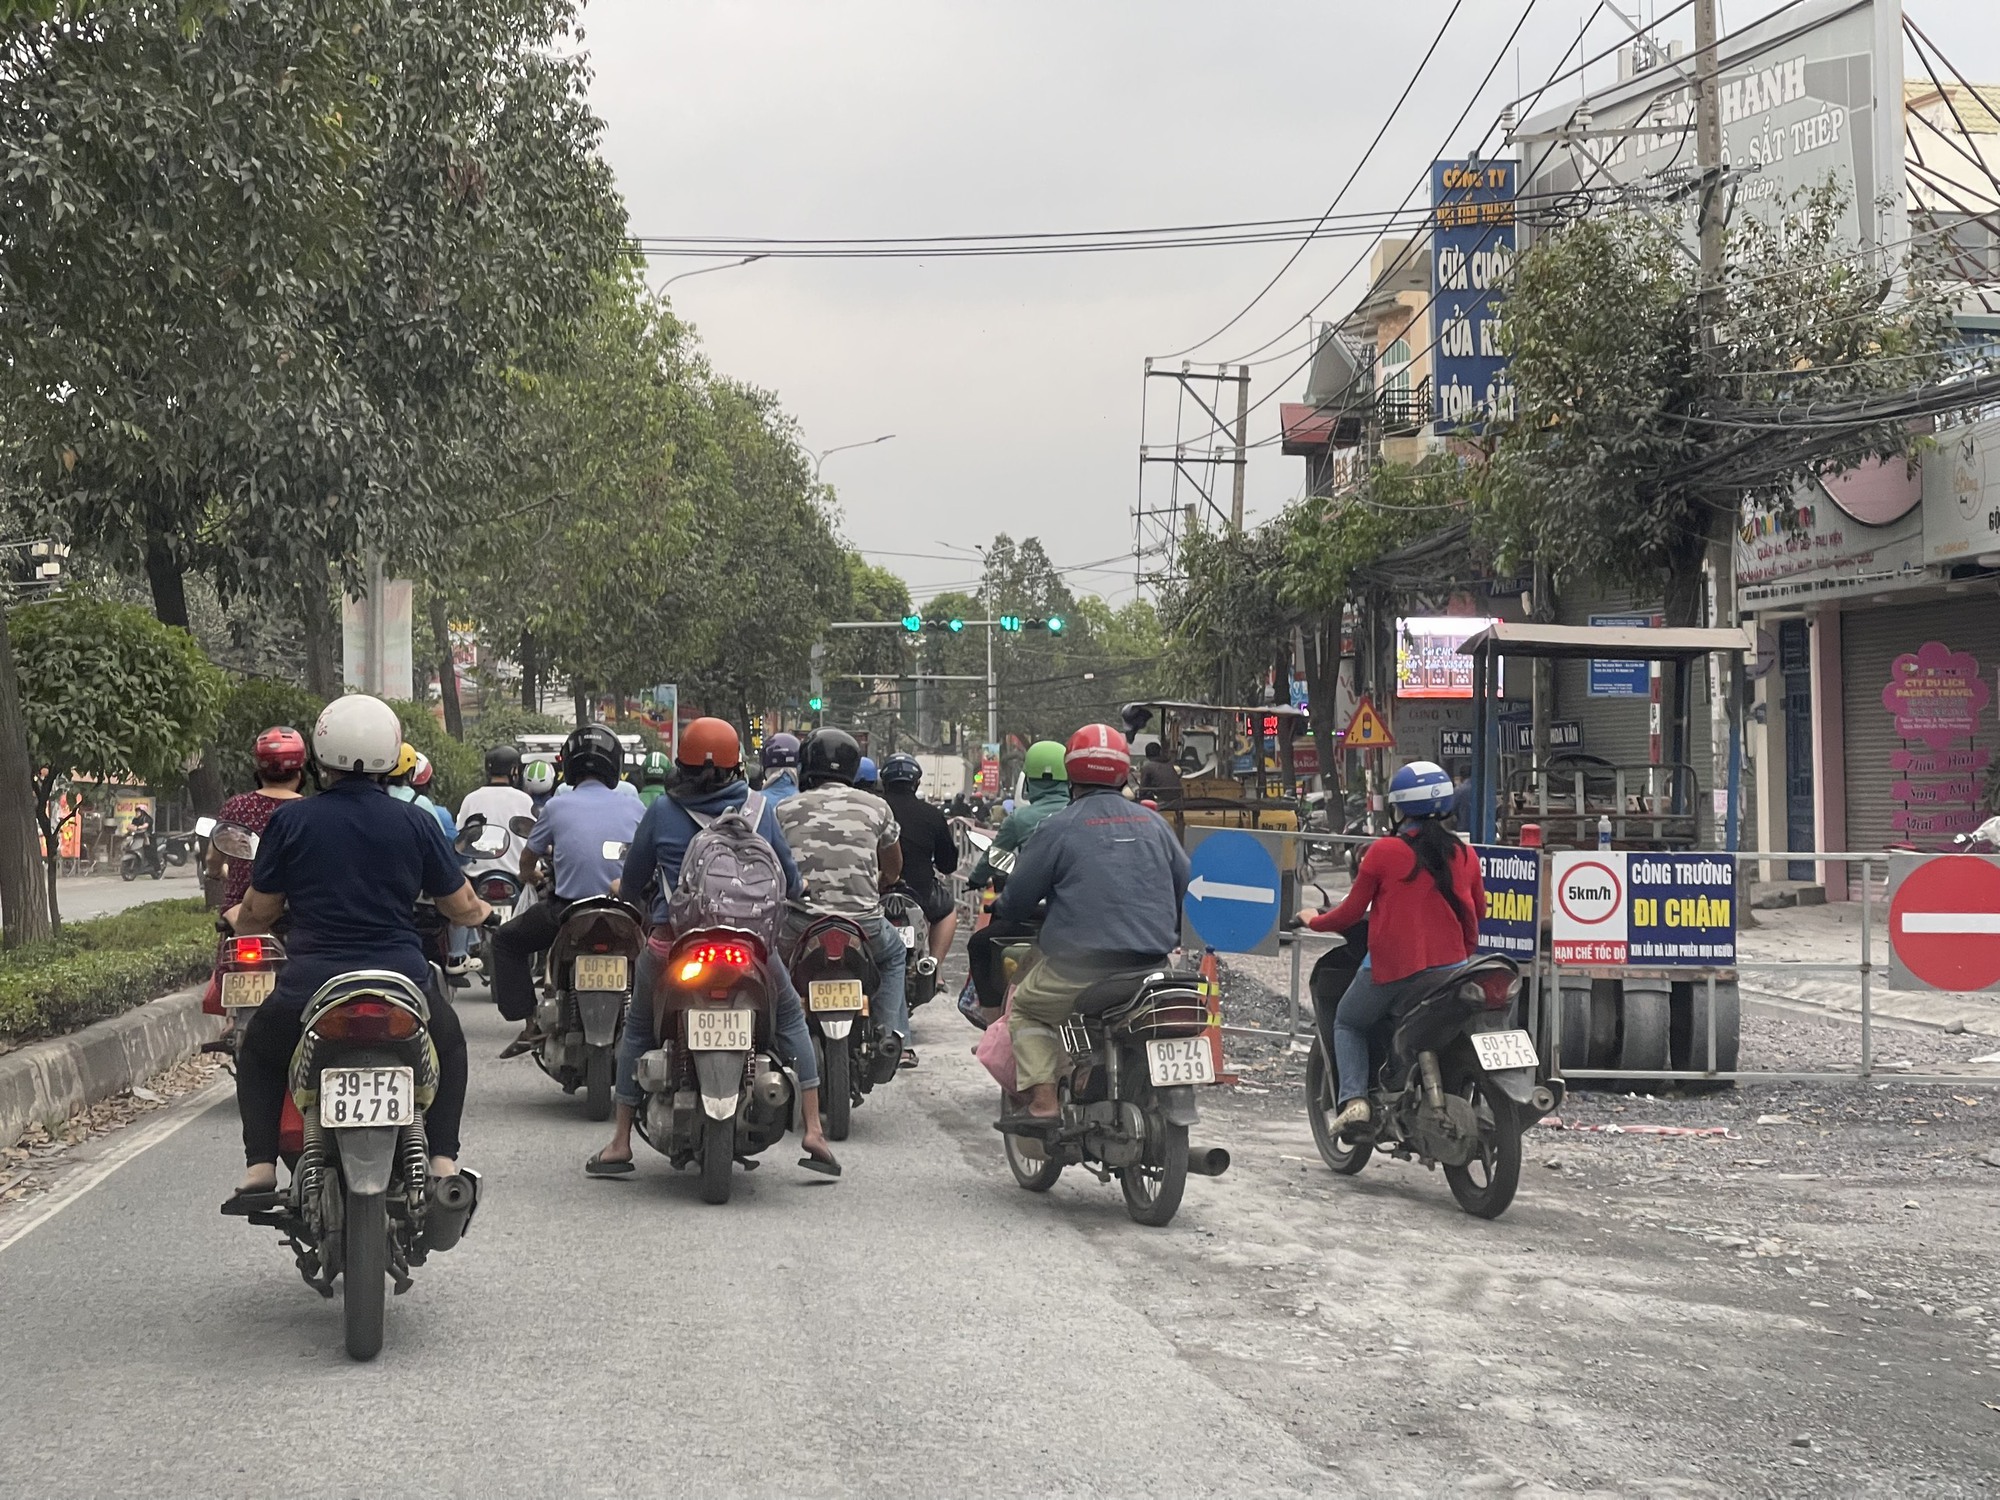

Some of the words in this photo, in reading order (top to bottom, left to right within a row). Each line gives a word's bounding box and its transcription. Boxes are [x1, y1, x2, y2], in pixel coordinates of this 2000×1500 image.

[1718, 55, 1805, 126] HÀNH
[1749, 115, 1786, 168] SẮT
[1790, 102, 1845, 156] THÉP
[1442, 163, 1484, 188] CÔNG
[1487, 168, 1507, 188] TY
[1441, 304, 1475, 357] CỬA
[1480, 309, 1514, 357] KÉ
[1440, 373, 1473, 422] TÔN
[1988, 505, 2000, 535] GỘ
[1896, 689, 1935, 698] PACIFIC
[1937, 689, 1975, 698] TRAVEL
[1904, 679, 1923, 687] CTY
[1926, 679, 1941, 687] DU
[647, 767, 664, 775] Grab
[1087, 764, 1115, 772] HONDA
[1490, 855, 1536, 881] TRƯỜNG
[1632, 859, 1672, 885] CÔNG
[1675, 859, 1732, 885] TRƯỜNG
[1568, 886, 1611, 901] 5km/h
[1484, 888, 1533, 926] CHẬM
[1634, 898, 1658, 927] ĐI
[1665, 894, 1731, 933] CHẬM
[1554, 946, 1574, 963] HẠN
[1575, 943, 1593, 960] CHẾ
[1595, 942, 1612, 960] TỐC
[1613, 945, 1627, 964] ĐỘ
[698, 1013, 740, 1029] 60-H1
[693, 1031, 747, 1047] 192.96
[1156, 1040, 1202, 1061] 60-Z4
[1481, 1034, 1522, 1051] 60-F2
[1482, 1049, 1534, 1068] 582.15
[1159, 1062, 1205, 1082] 3239
[335, 1071, 399, 1097] 39-F4
[334, 1098, 400, 1122] 8478
